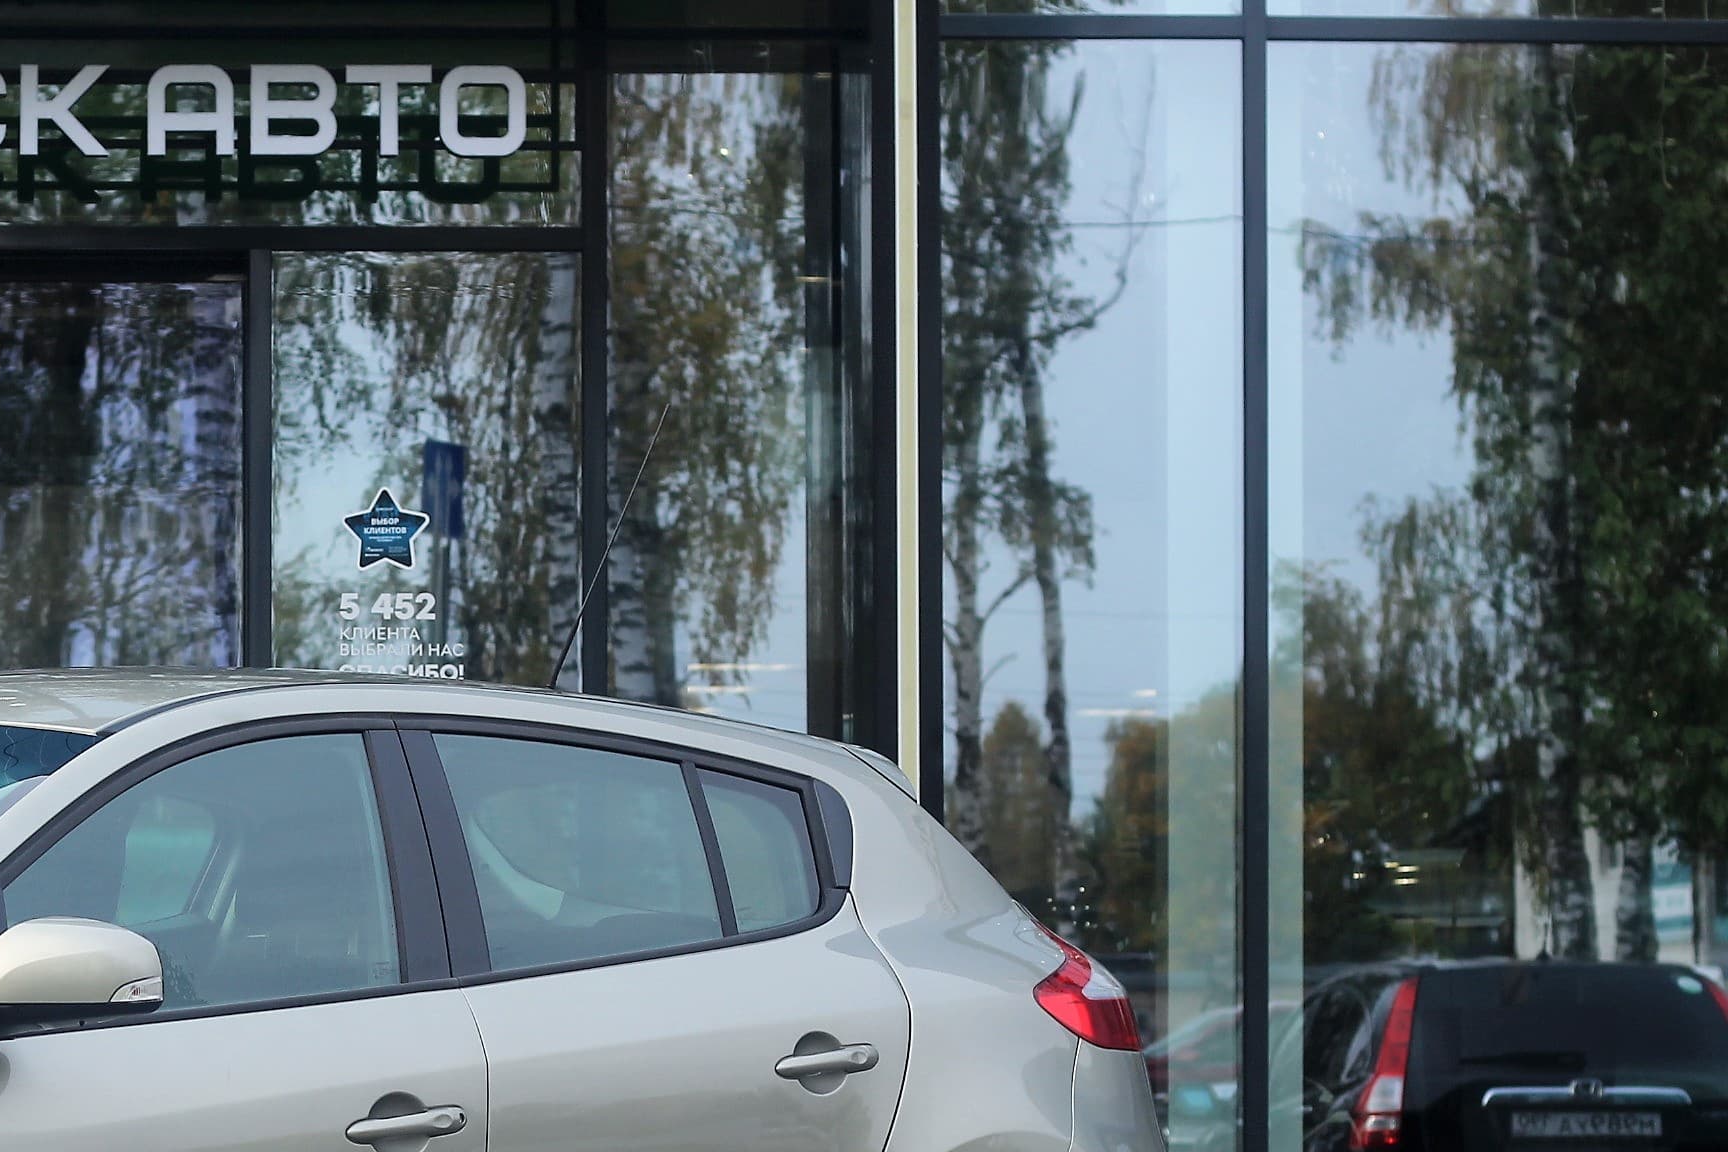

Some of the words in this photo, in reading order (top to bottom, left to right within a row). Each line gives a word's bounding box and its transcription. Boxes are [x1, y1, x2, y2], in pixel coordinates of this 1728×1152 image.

[147, 63, 528, 157] АВТО
[339, 593, 360, 620] 5
[371, 593, 436, 620] 452
[340, 627, 420, 640] КЛИЕНТА
[340, 643, 423, 656] ВЫБРАЛИ
[428, 643, 464, 657] НАС
